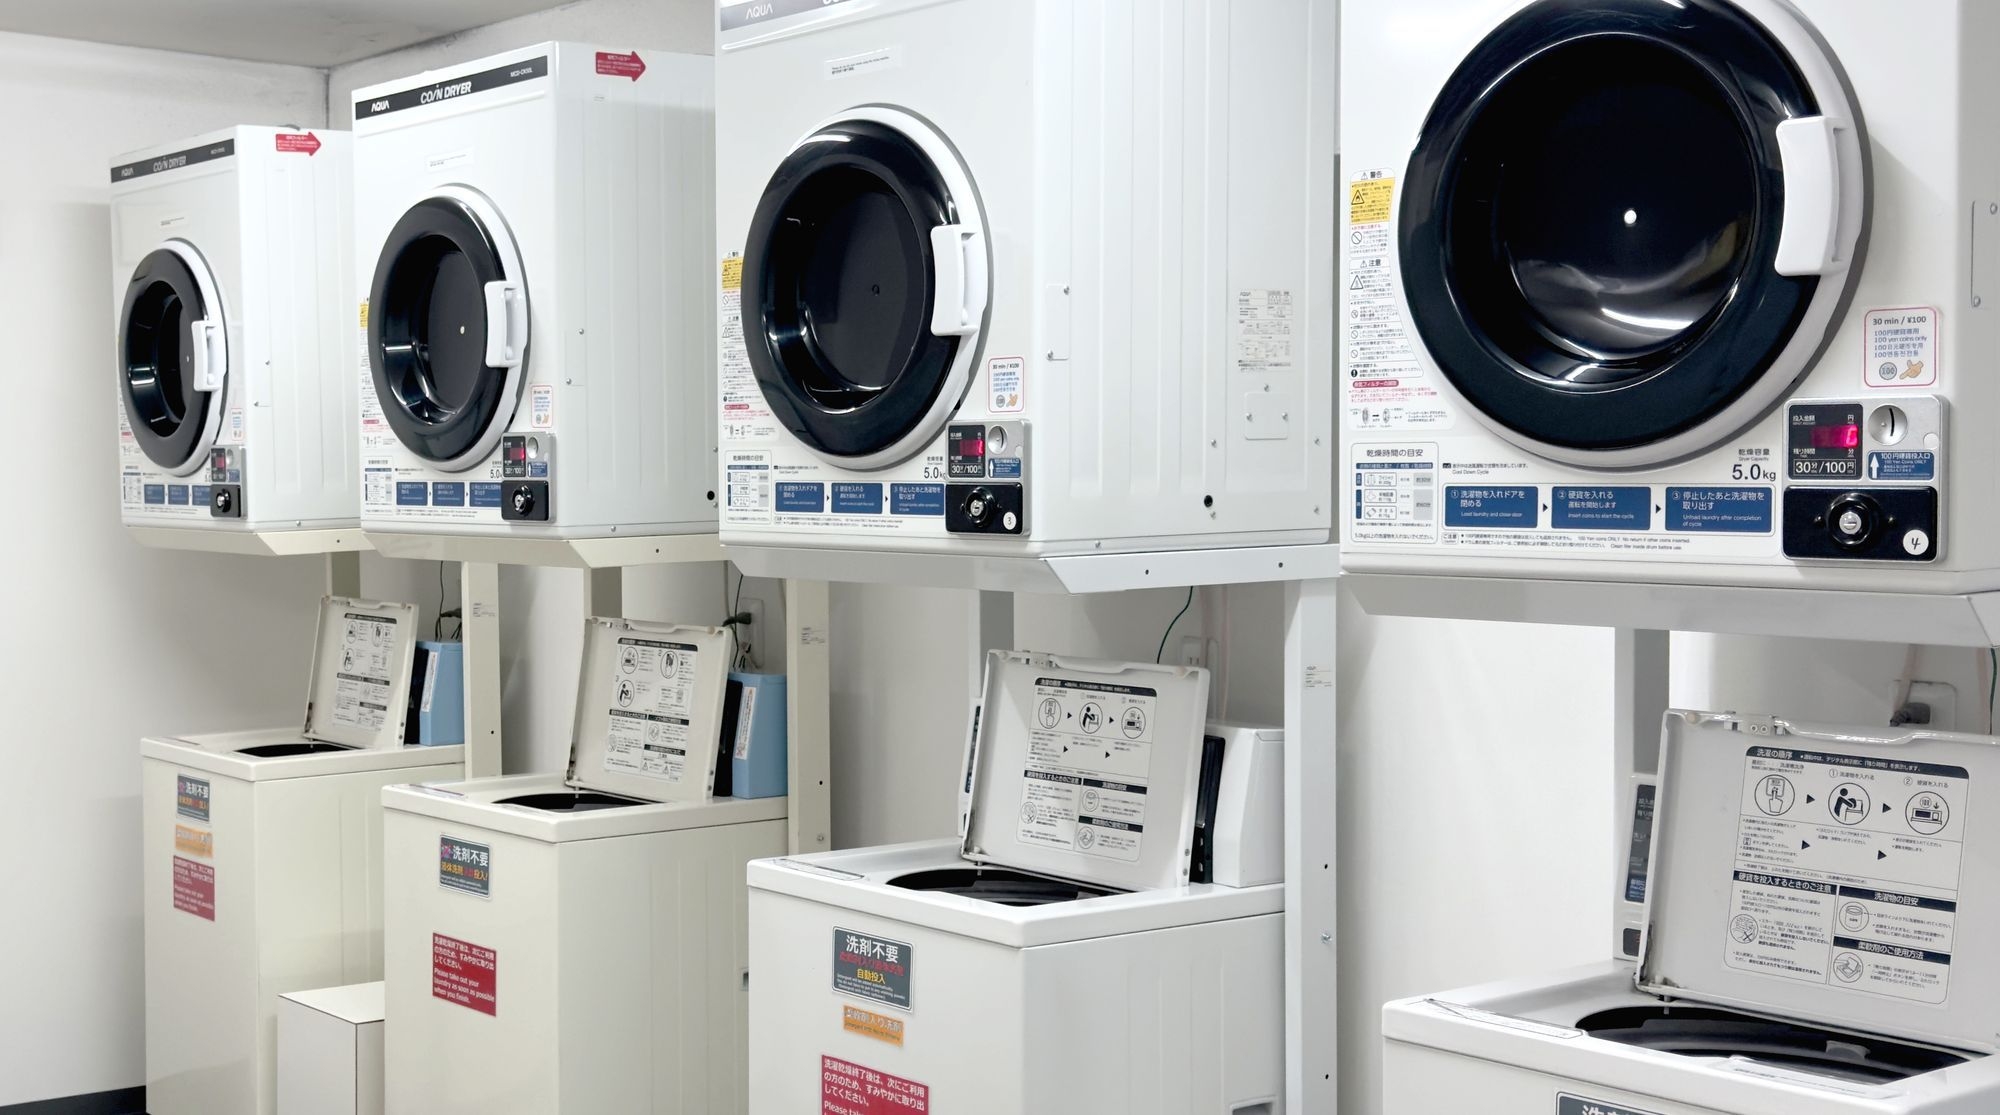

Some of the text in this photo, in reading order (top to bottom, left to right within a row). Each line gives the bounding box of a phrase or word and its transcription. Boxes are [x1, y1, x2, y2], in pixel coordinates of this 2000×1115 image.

[746, 2, 773, 20] AQUA
[371, 100, 390, 113] AQUA
[444, 81, 472, 99] DRYER
[121, 167, 134, 177] AQUA
[1368, 259, 1381, 267] 注意
[1366, 448, 1424, 457] 乾燥時間の目安
[1738, 448, 1770, 456] 乾燥容量
[1460, 490, 1525, 499] 洗濯物を入れドアを
[1568, 490, 1614, 499] 硬貨を入れる
[1683, 492, 1764, 501] 停止したあと洗濯物を
[1460, 499, 1482, 508] 閉める
[1568, 501, 1616, 509] 運転を開始します
[1683, 502, 1715, 510] 取り出す
[1911, 537, 1920, 550] 4
[1756, 748, 1793, 760] 洗濯の順序
[1839, 771, 1875, 781] 洗濯物を入れる
[1917, 780, 1949, 789] 硬貨を入れる
[452, 845, 488, 867] 洗剤不要
[1738, 872, 1831, 894] 硬貨を投入するときのご注意
[1874, 891, 1919, 906] 洗濯物の目安
[846, 934, 899, 964] 洗剤不要
[1858, 941, 1924, 960] 柔軟剤のご使用方法
[856, 968, 886, 984] 自動投入
[824, 1059, 925, 1098] 洗濯乾燥終了後は、次にご利用
[824, 1071, 925, 1111] の方のため、すみやかに取り出
[824, 1083, 870, 1107] してください。
[824, 1100, 848, 1115] Please
